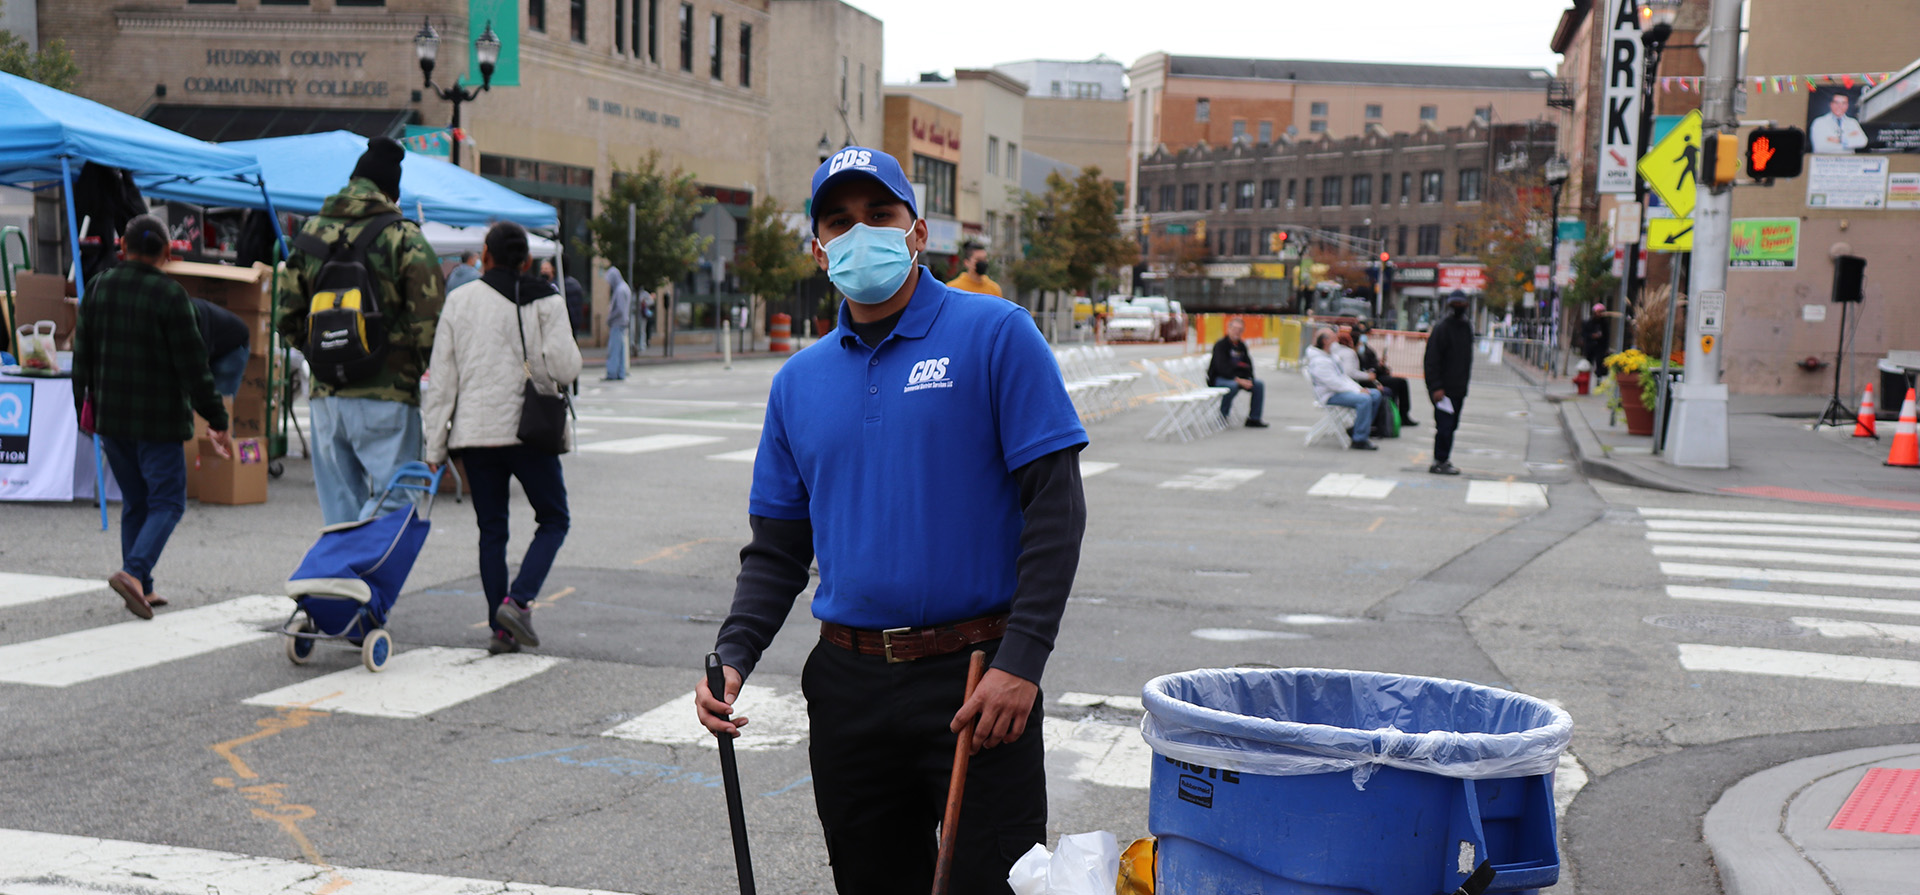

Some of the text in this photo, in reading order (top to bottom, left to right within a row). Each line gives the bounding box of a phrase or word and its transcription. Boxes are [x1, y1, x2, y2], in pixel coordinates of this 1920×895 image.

[206, 49, 366, 67] HUDSON COUNTY
[184, 76, 388, 97] COMMUNITY COLLEGE
[829, 149, 872, 176] CDS
[1762, 225, 1791, 236] We're
[1761, 234, 1794, 252] Open!
[909, 357, 950, 384] CDS
[1181, 780, 1211, 794] Rubbermaid
